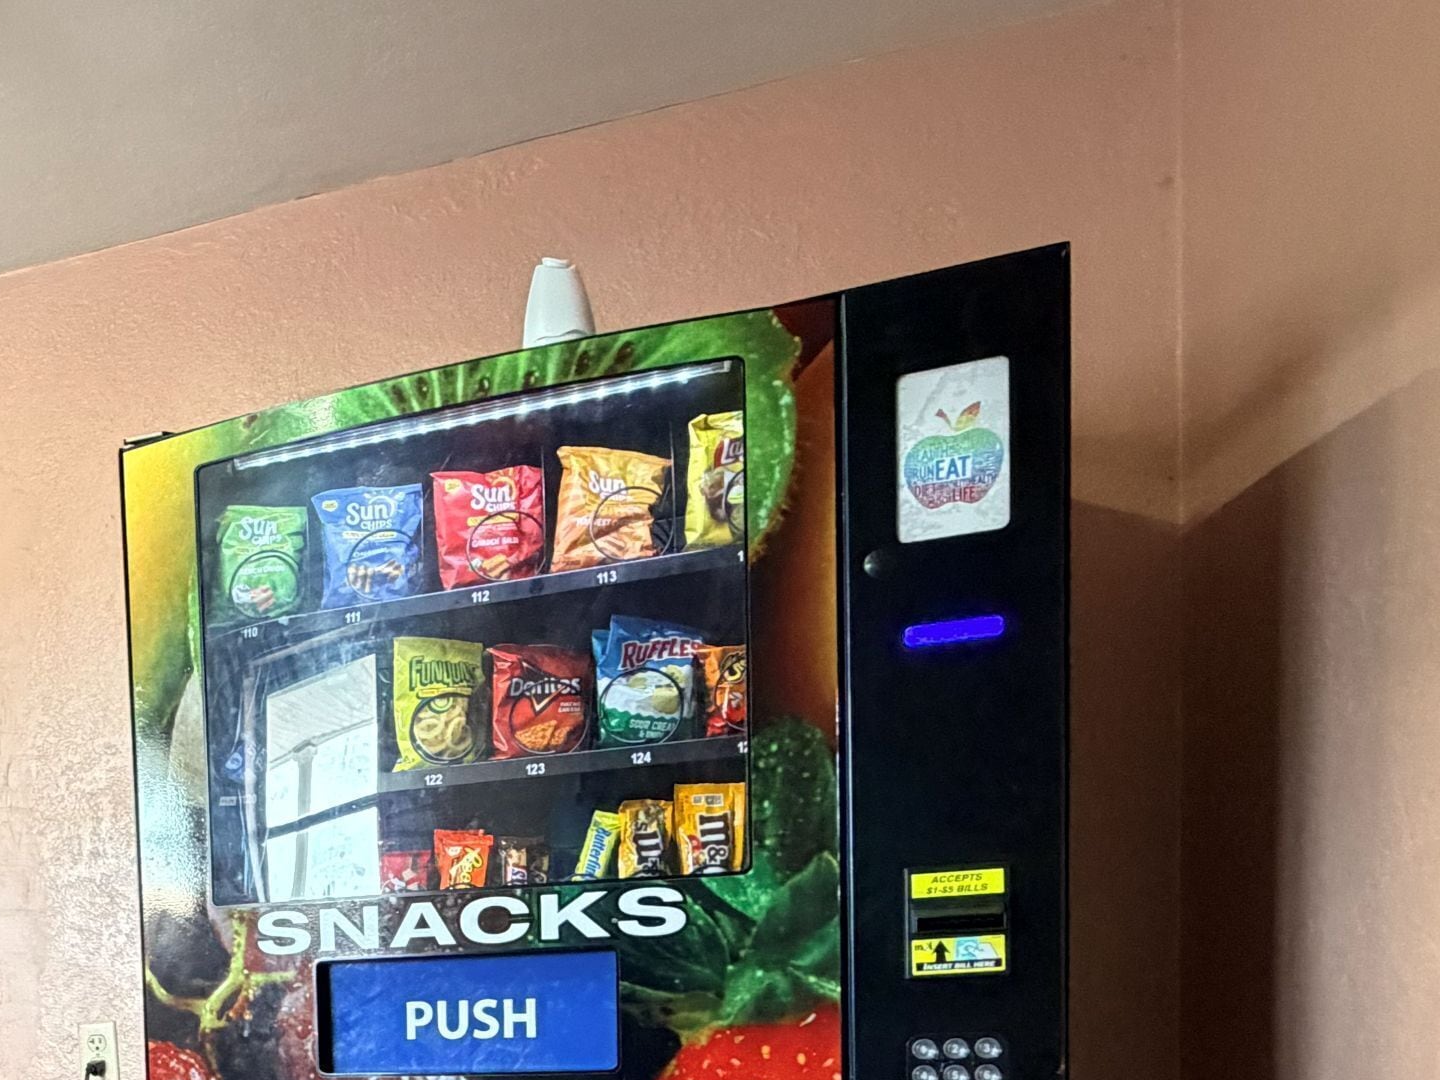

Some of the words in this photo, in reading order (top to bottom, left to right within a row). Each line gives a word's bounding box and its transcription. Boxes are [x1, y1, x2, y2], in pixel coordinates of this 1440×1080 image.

[936, 455, 971, 480] EAT
[589, 470, 627, 494] Sun
[470, 484, 511, 510] Sun
[345, 502, 389, 526] Sun
[239, 516, 278, 540] Sun
[361, 520, 392, 532] CHIPS
[597, 571, 617, 584] 113
[472, 591, 490, 603] 112
[345, 612, 361, 624] 111
[243, 627, 258, 638] 110
[620, 636, 702, 669] RUFFLES
[510, 677, 581, 697] Doritos
[631, 752, 651, 765] 124
[526, 764, 546, 776] 123
[424, 775, 443, 787] 122
[931, 873, 983, 884] ACCEPTS
[926, 886, 954, 895] $1-$5
[956, 883, 988, 893] BILLS
[259, 886, 688, 956] SNACKS
[405, 997, 537, 1040] PUSH
